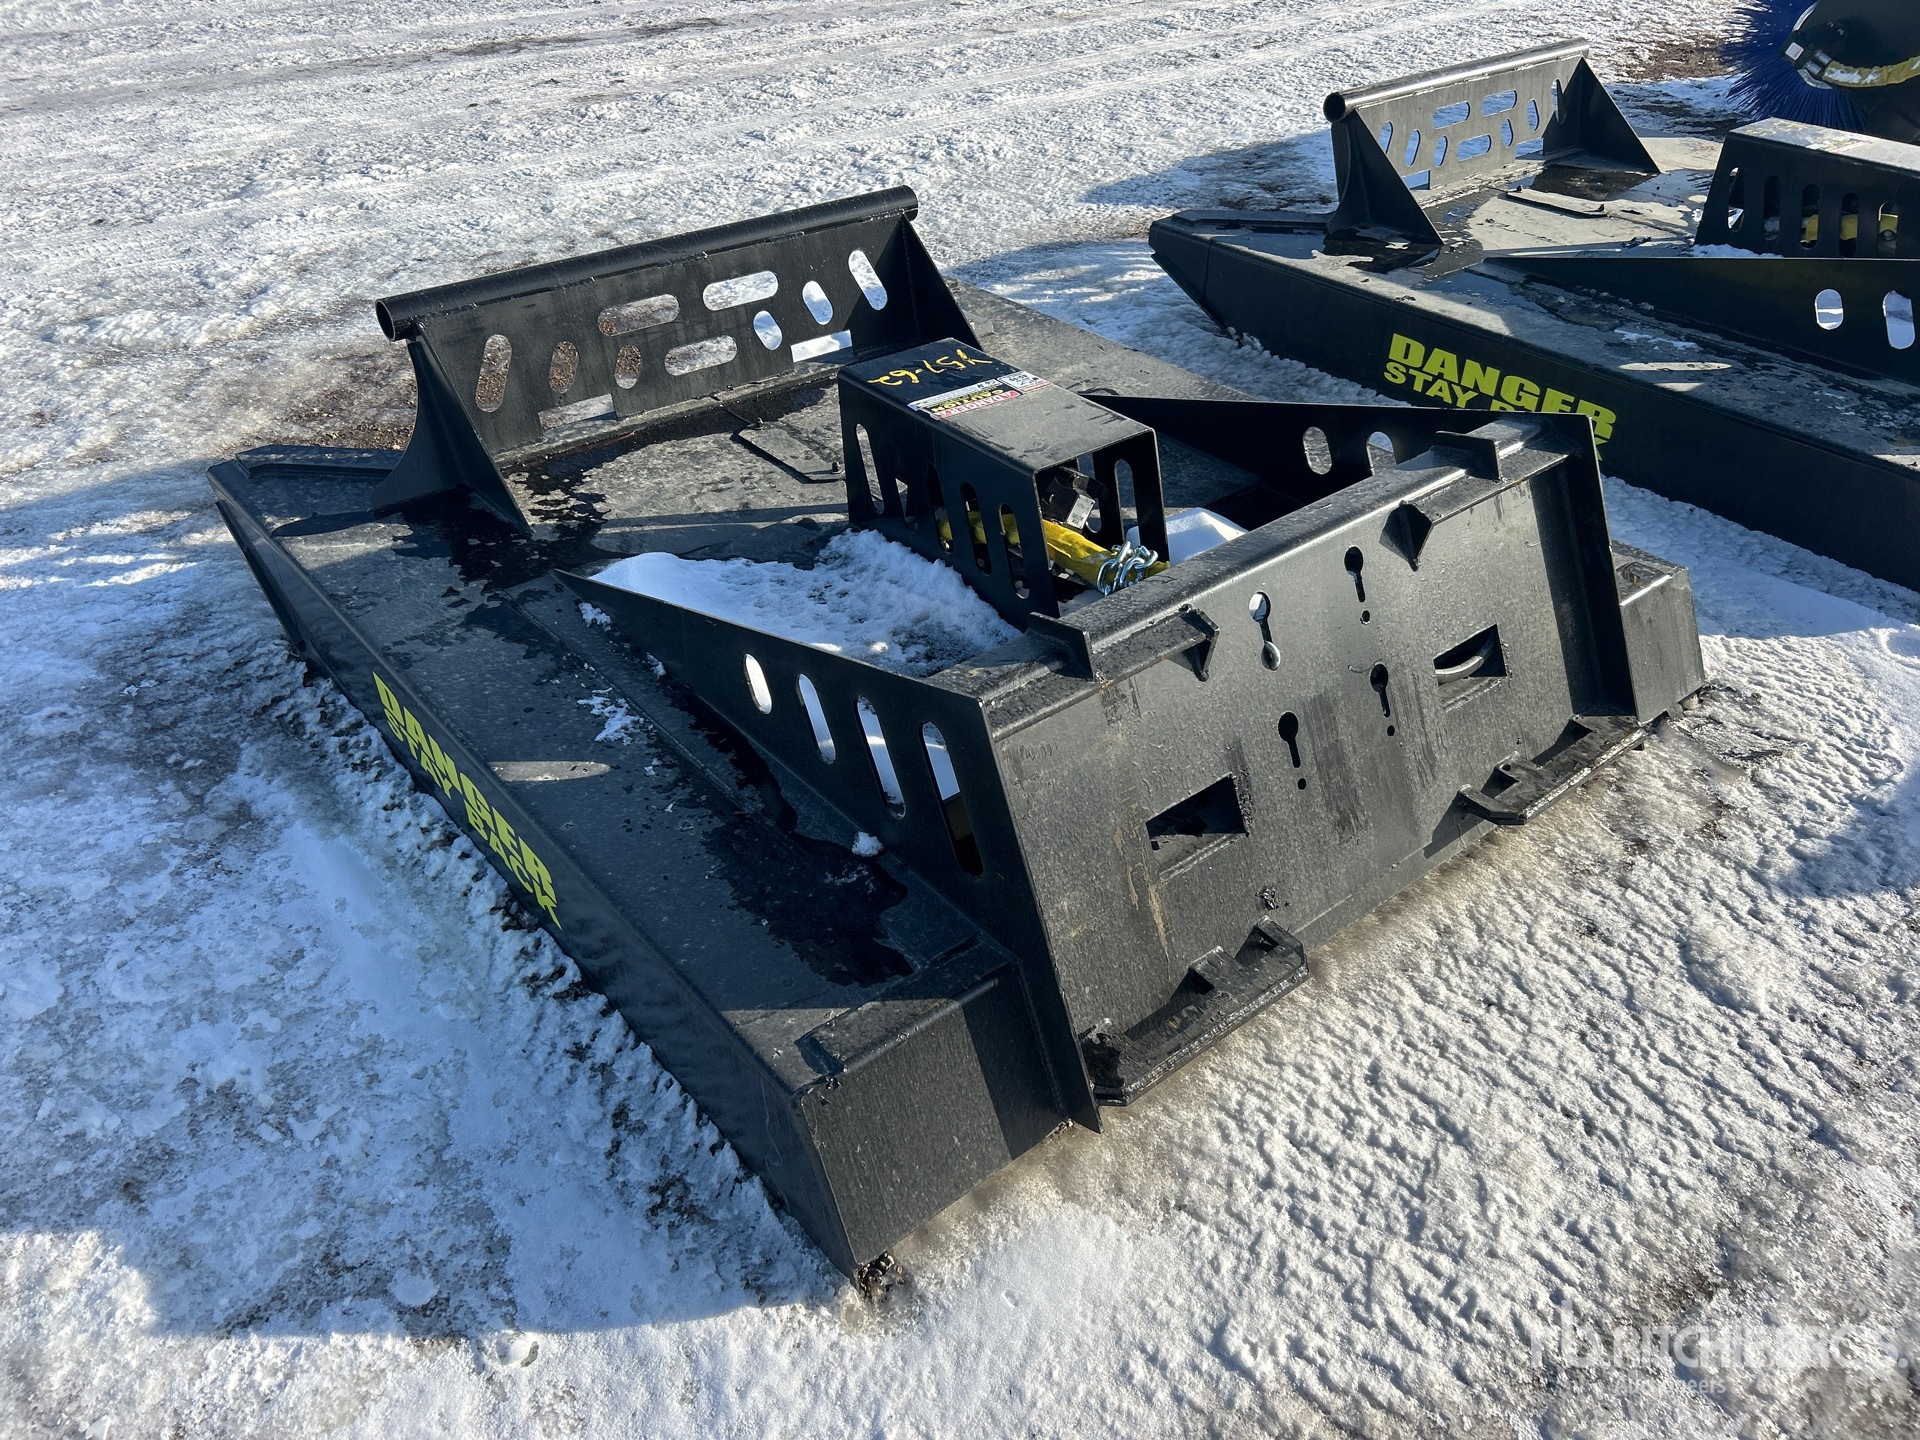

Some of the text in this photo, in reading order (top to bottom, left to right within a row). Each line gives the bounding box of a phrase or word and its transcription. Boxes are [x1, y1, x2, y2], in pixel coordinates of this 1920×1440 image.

[931, 389, 1004, 413] CAUTION
[952, 395, 1001, 415] DANGER
[1383, 361, 1479, 409] STAY
[1388, 333, 1617, 440] DANGER
[372, 671, 557, 908] DANGER
[384, 707, 563, 931] STAY BACK
